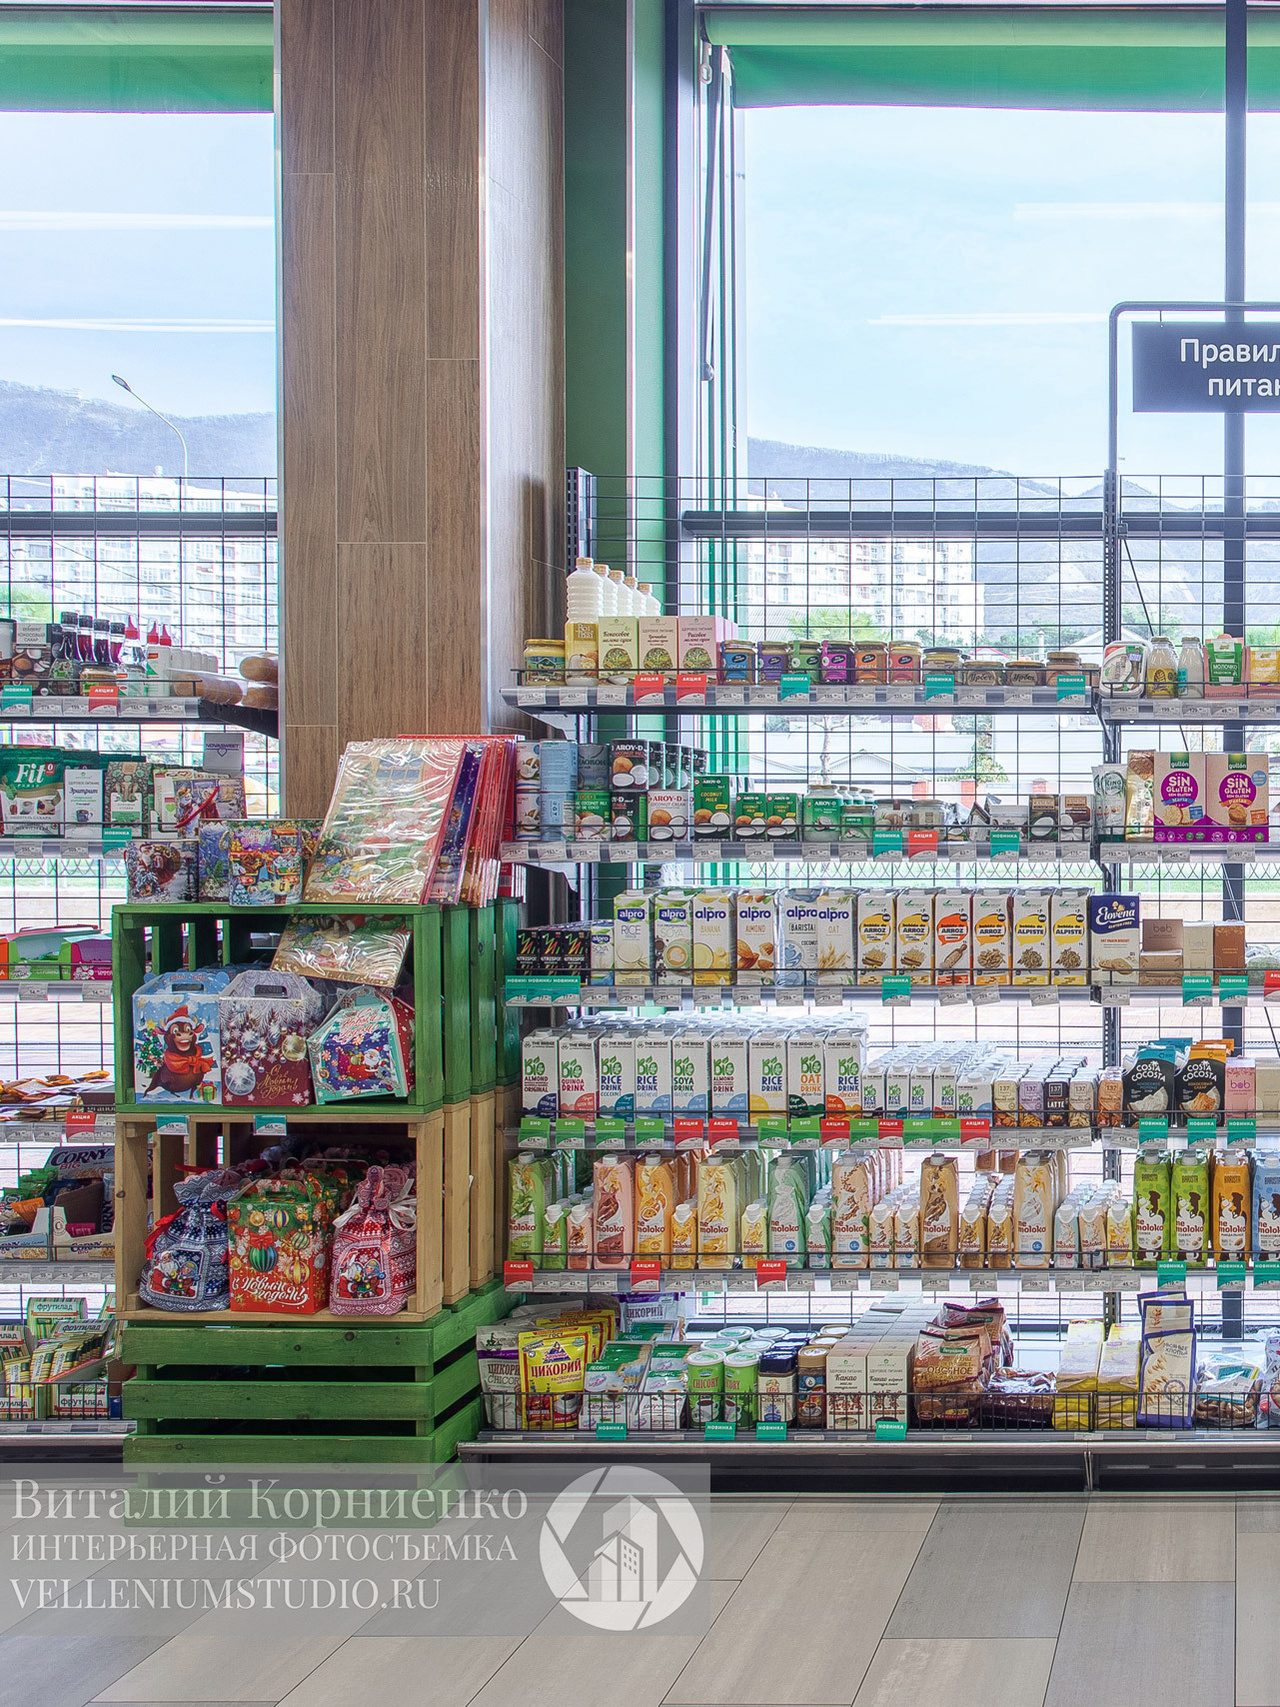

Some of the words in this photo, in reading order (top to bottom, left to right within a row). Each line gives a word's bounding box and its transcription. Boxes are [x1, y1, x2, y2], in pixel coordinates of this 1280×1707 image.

[14, 763, 46, 783] Fit
[620, 910, 644, 920] alpro
[660, 910, 685, 920] alpro
[695, 907, 726, 922] alpro
[740, 907, 771, 922] alpro
[786, 906, 817, 920] alpro
[819, 907, 849, 922] alpro
[1097, 906, 1136, 925] Elovena
[621, 926, 641, 934] RICE
[1153, 923, 1172, 933] bob
[1136, 1064, 1161, 1072] COSTA
[1187, 1064, 1212, 1072] COSTA
[601, 1076, 621, 1084] RICE
[637, 1076, 657, 1084] RICE
[762, 1076, 782, 1084] RICE
[801, 1075, 821, 1083] OAT
[838, 1076, 859, 1084] RICE
[1131, 1072, 1166, 1082] COCOSTA
[1182, 1071, 1217, 1082] COCOSTA
[1230, 1080, 1250, 1088] bob
[51, 1148, 113, 1167] CORNY
[242, 1275, 286, 1293] Новым
[488, 1364, 520, 1375] ЦИКОРИ
[531, 1359, 581, 1378] ЦИКОРИЙ
[692, 1378, 718, 1389] CHICORY
